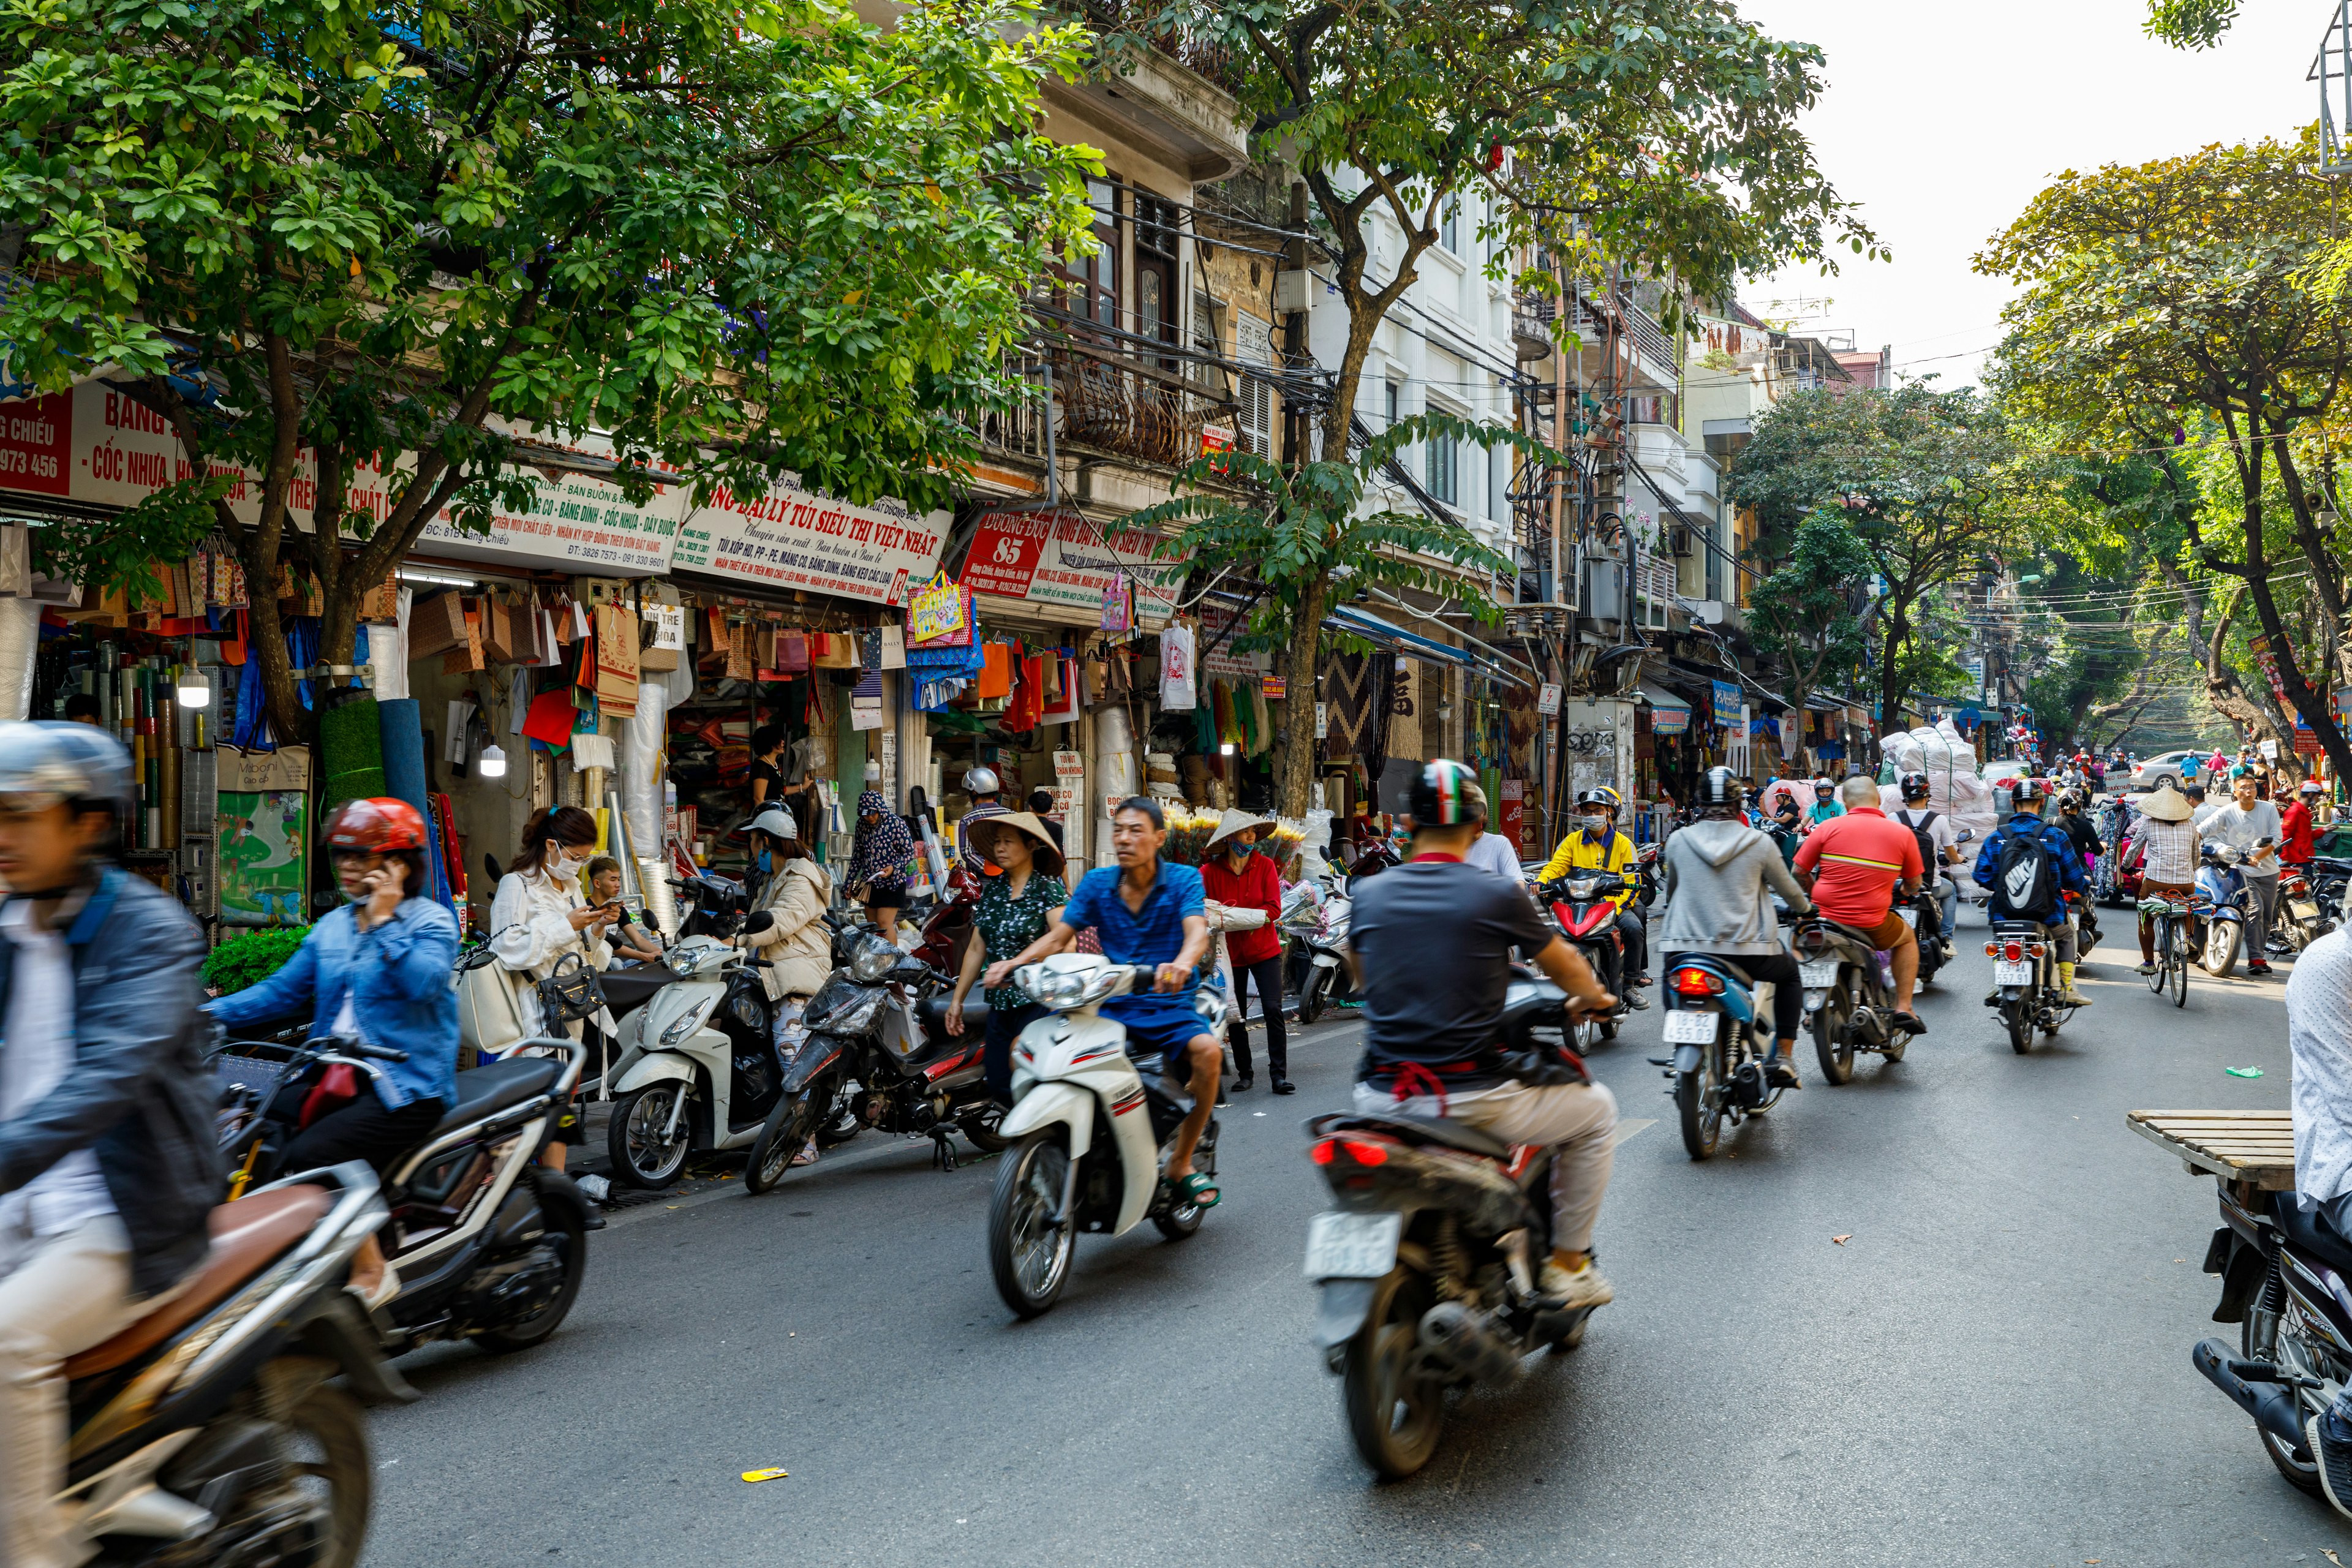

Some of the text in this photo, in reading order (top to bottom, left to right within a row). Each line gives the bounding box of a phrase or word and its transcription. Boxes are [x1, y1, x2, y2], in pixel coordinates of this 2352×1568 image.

[11, 416, 54, 445] CHIẾU
[31, 454, 58, 478] 456
[92, 436, 123, 482] CỐC
[568, 484, 586, 497] BÁN
[587, 488, 611, 502] BUÔN
[542, 499, 554, 516] CO
[559, 500, 581, 521] BĂNG
[580, 503, 600, 524] DÍNH
[604, 505, 619, 527] CỐC
[619, 512, 639, 532] NHỰA
[643, 514, 658, 533] DÂY
[657, 517, 676, 539] BUỘC
[767, 495, 938, 560] LÝ TÚI SIÊU THỊ VIỆT NHẬT
[1025, 516, 1049, 540] ĐỨC
[426, 525, 442, 535] ĐC:
[444, 527, 459, 538] 81B
[486, 533, 509, 545] Chiếu
[510, 519, 521, 533] MỌI
[523, 518, 538, 534] CHẤT
[538, 521, 553, 538] LIỆU
[556, 525, 573, 541] NHẬN
[573, 526, 582, 541] KÝ
[582, 529, 593, 545] HỢP
[609, 535, 624, 548] THEO
[624, 537, 635, 549] ĐƠN
[568, 545, 665, 567] ĐT: 3826 7573 091 330 9601
[815, 539, 831, 552] Bán
[832, 543, 850, 556] buôn
[992, 537, 1024, 564] 85
[717, 537, 729, 552] TÚI
[728, 537, 744, 554] XỐP
[754, 545, 766, 559] PP
[778, 549, 797, 567] MÀNG
[808, 556, 826, 571] BĂNG
[840, 562, 856, 578] BĂNG
[856, 567, 869, 581] KEO
[869, 569, 878, 583] CÁC
[879, 571, 894, 587] LOẠI
[747, 564, 754, 573] IN
[890, 572, 906, 601] 83
[662, 614, 679, 625] TRE
[1060, 800, 1069, 810] CỠ
[1062, 790, 1072, 799] CO
[2299, 1306, 2332, 1334] DREAM
